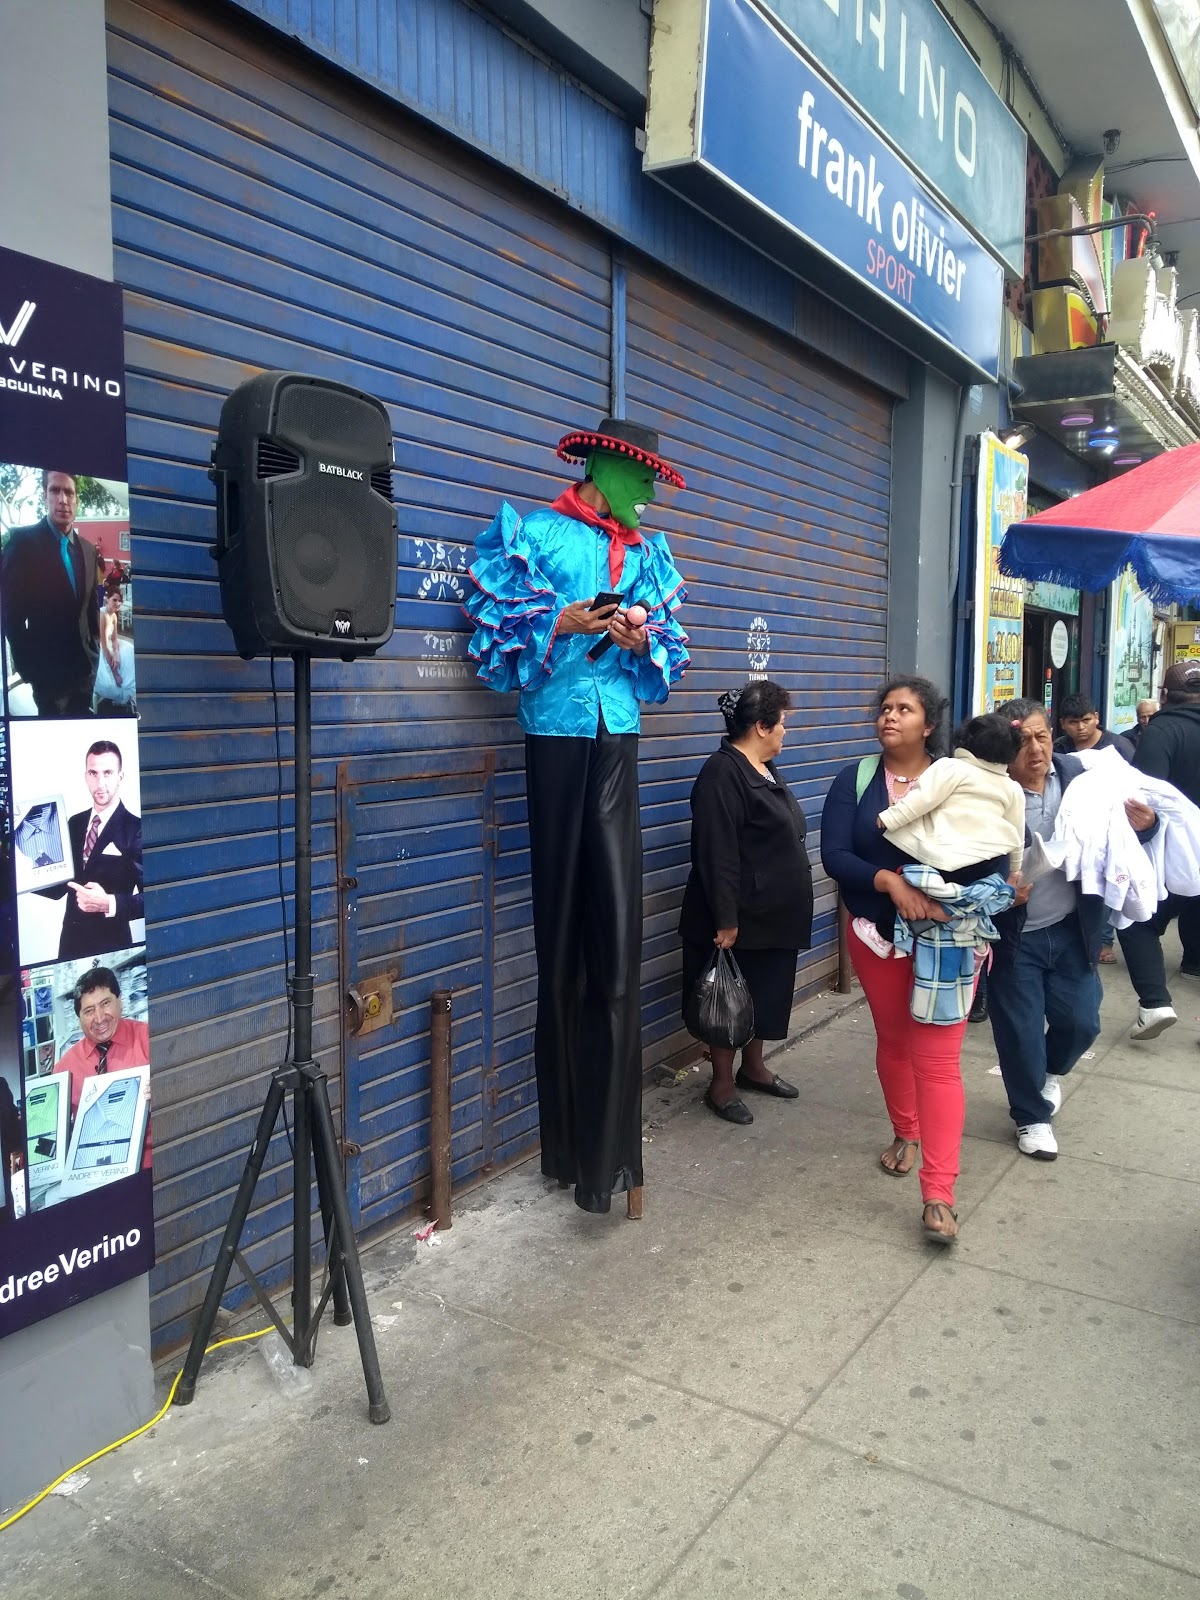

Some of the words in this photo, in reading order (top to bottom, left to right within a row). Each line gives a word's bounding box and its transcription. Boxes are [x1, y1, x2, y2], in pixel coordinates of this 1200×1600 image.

[823, 0, 977, 178] RINO
[798, 90, 885, 234] frank
[892, 197, 967, 302] olivier
[866, 238, 916, 304] SPORT
[9, 356, 121, 397] VERINO
[319, 463, 364, 481] BATBLACK
[417, 666, 468, 678] VIGILADA
[749, 673, 768, 681] TIENDA
[0, 1228, 141, 1304] dreeVerino
